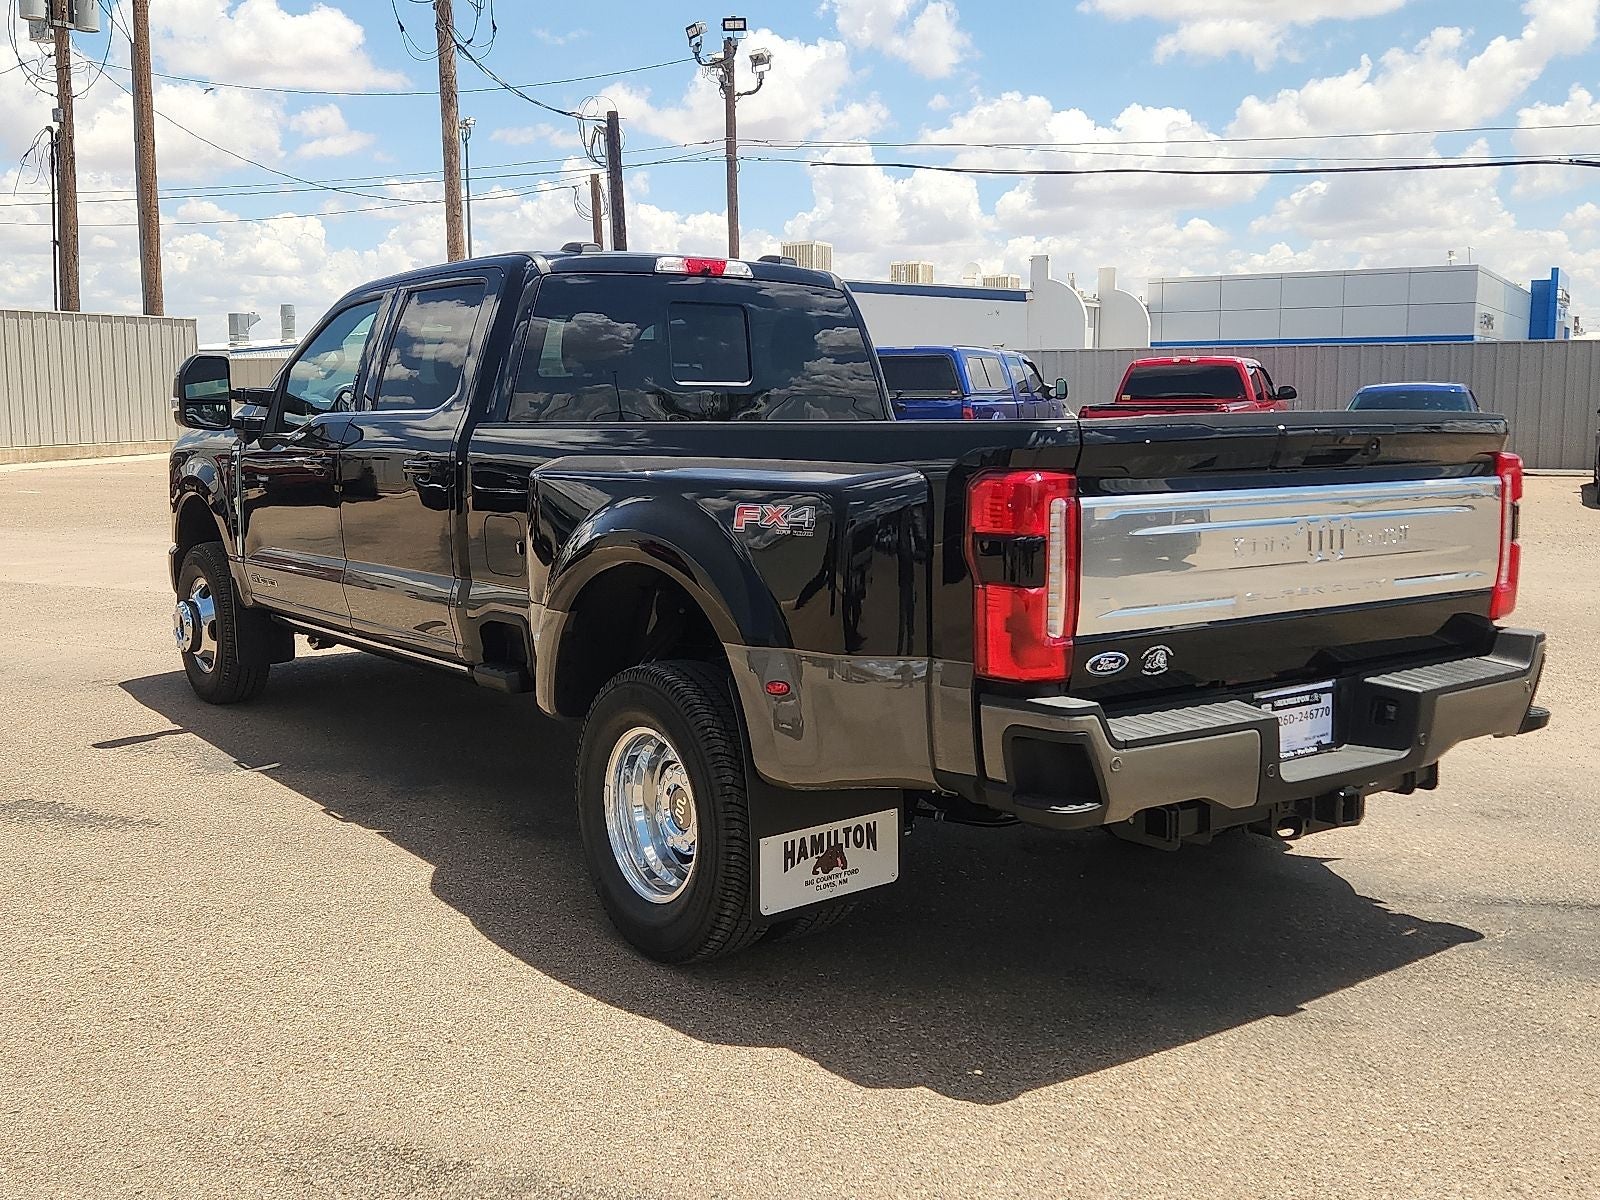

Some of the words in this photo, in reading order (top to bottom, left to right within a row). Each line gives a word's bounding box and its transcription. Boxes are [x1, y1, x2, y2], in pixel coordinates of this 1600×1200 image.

[733, 503, 816, 532] FX4
[783, 820, 878, 874] HAMILTON
[804, 879, 815, 887] BIG
[815, 872, 842, 885] COUNTRY
[843, 868, 860, 877] FORD
[815, 882, 838, 892] CLOVIS,
[838, 878, 848, 886] NM
